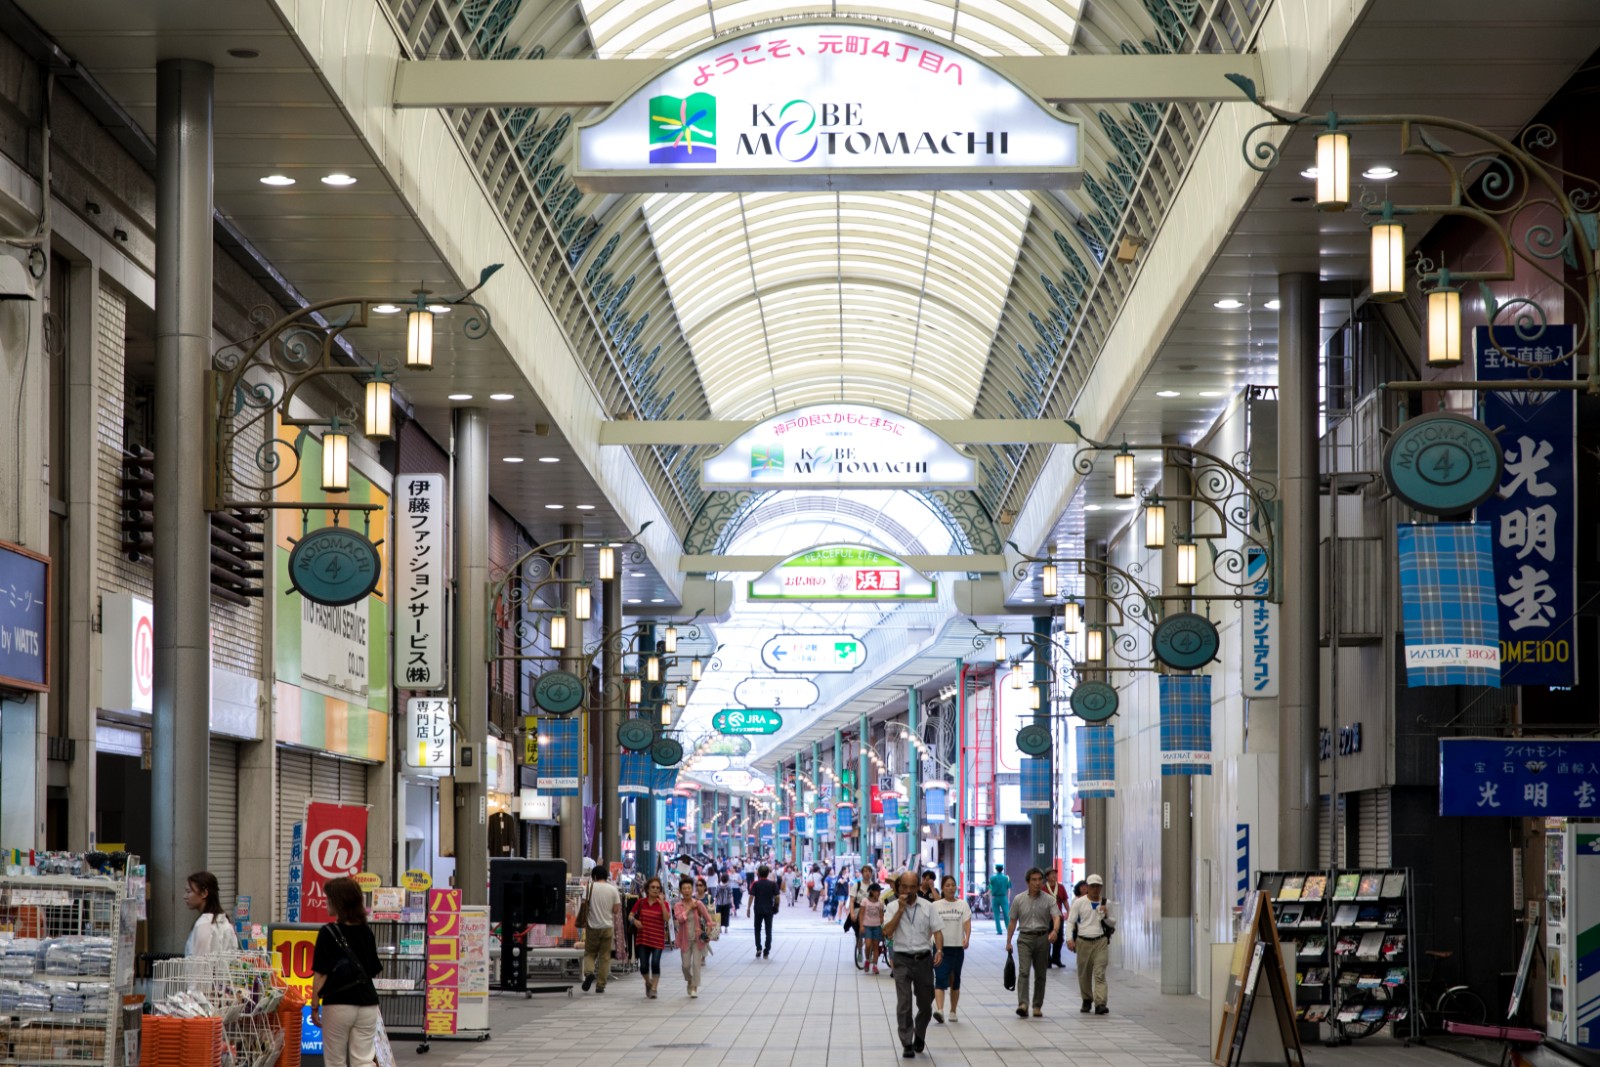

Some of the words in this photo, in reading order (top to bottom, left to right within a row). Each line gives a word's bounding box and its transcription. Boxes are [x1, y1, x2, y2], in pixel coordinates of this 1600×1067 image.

[751, 99, 863, 136] KOBE
[735, 119, 1009, 163] MOTOMACHI
[772, 412, 906, 437] 神戸の良さがもとまちに
[801, 446, 856, 464] KOBE
[1396, 425, 1492, 471] MOTOMACHI
[793, 456, 927, 475] MOTOMACHI
[1432, 448, 1455, 479] 4
[299, 537, 371, 573] MOTOMACHI
[325, 555, 341, 579] 4
[804, 549, 854, 563] PEACEFUL
[857, 552, 879, 563] LIFE
[858, 570, 899, 590] 浜屋
[342, 608, 366, 646] SERVICE
[2, 624, 12, 655] by
[14, 626, 39, 657] WATTS
[1180, 633, 1192, 651] 4
[1498, 639, 1569, 663] OMEIDO
[416, 700, 429, 739] 専門店
[432, 700, 445, 762] ストレッチ
[745, 714, 766, 724] JRA
[1503, 746, 1567, 758] ダイヤモンド
[426, 890, 459, 1035] パソコン教室
[301, 1041, 323, 1051] WATT
